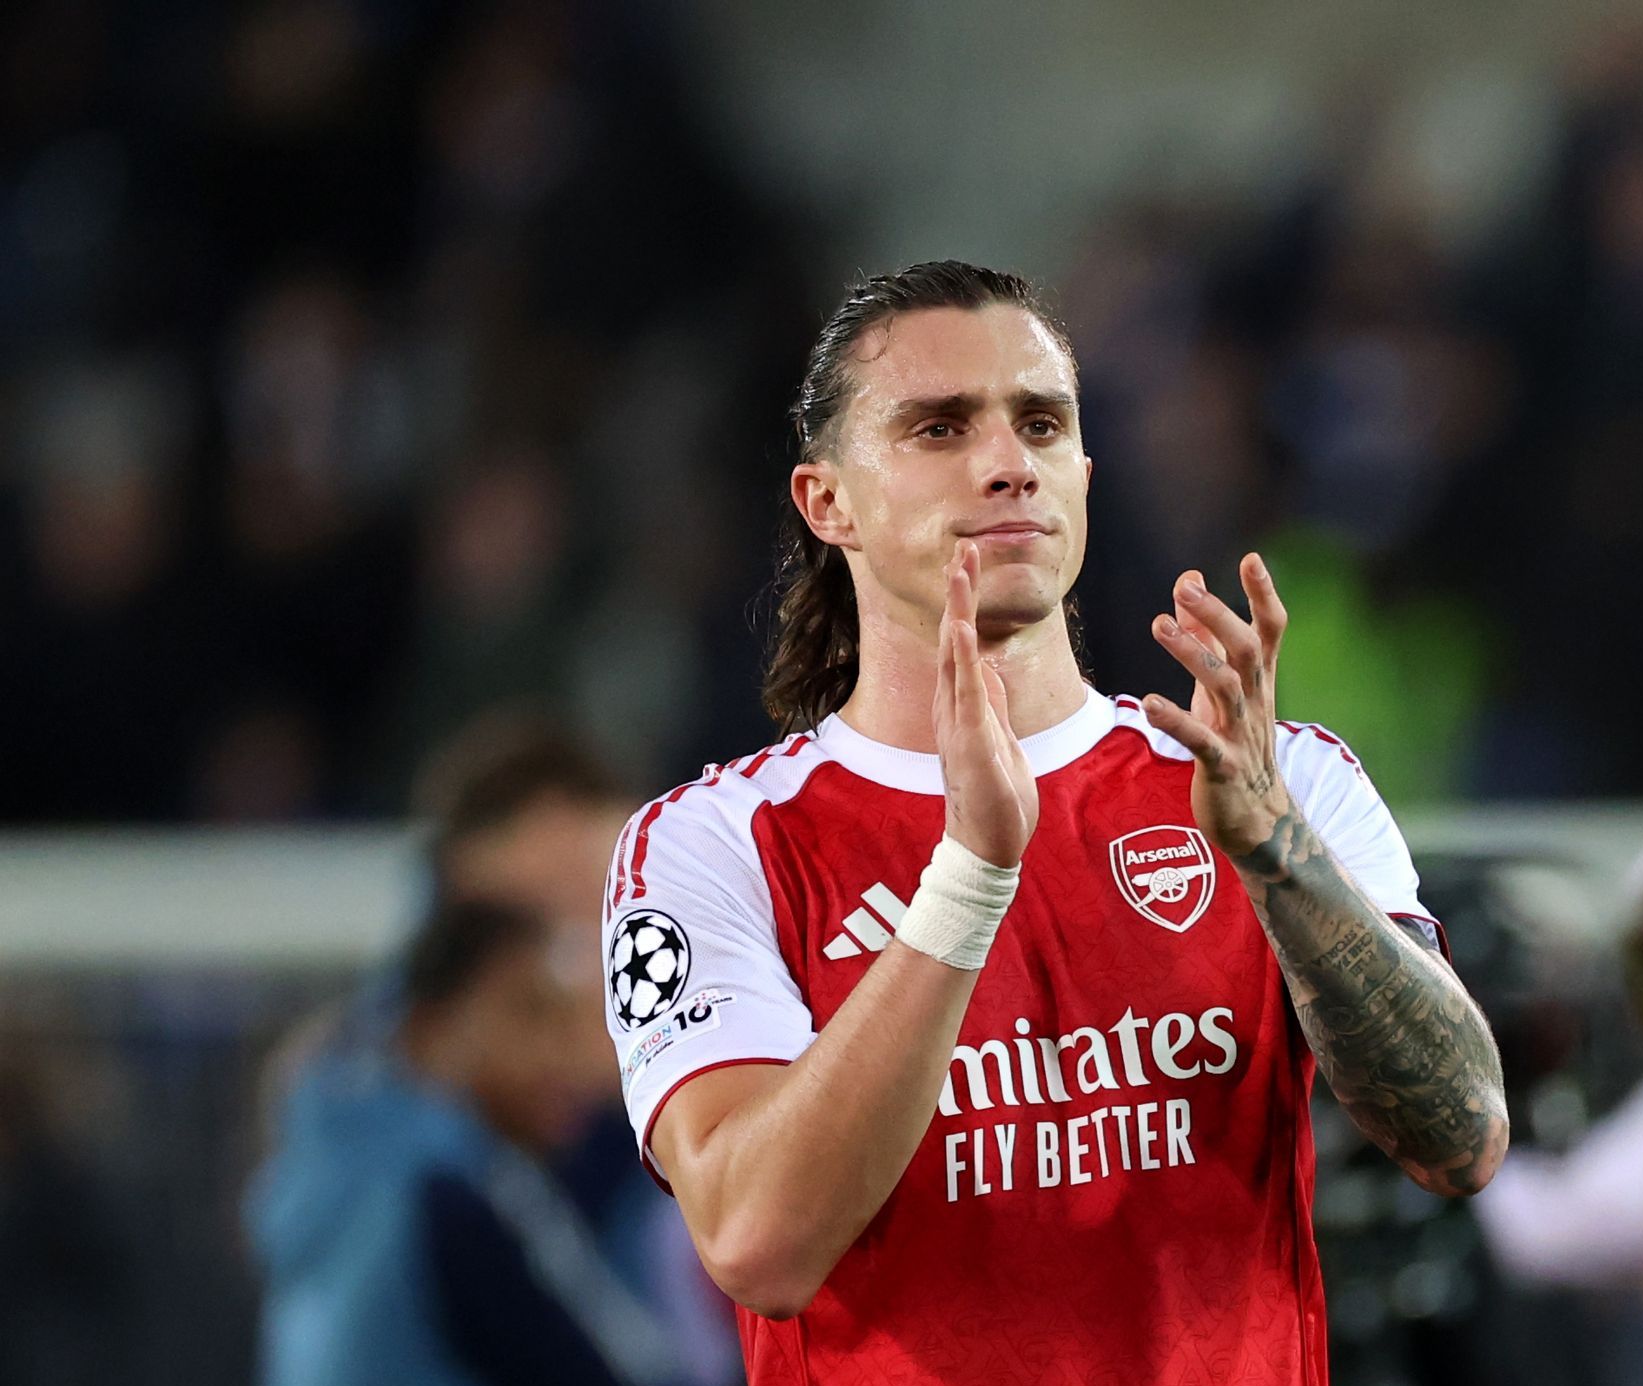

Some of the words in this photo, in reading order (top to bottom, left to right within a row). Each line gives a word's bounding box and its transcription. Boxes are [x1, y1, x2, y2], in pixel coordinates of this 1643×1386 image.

[1126, 841, 1197, 866] Arsenal
[673, 1001, 712, 1031] 10
[938, 1005, 1237, 1117] mirates
[945, 1123, 1016, 1203] FLY
[1036, 1098, 1196, 1188] BETTER
